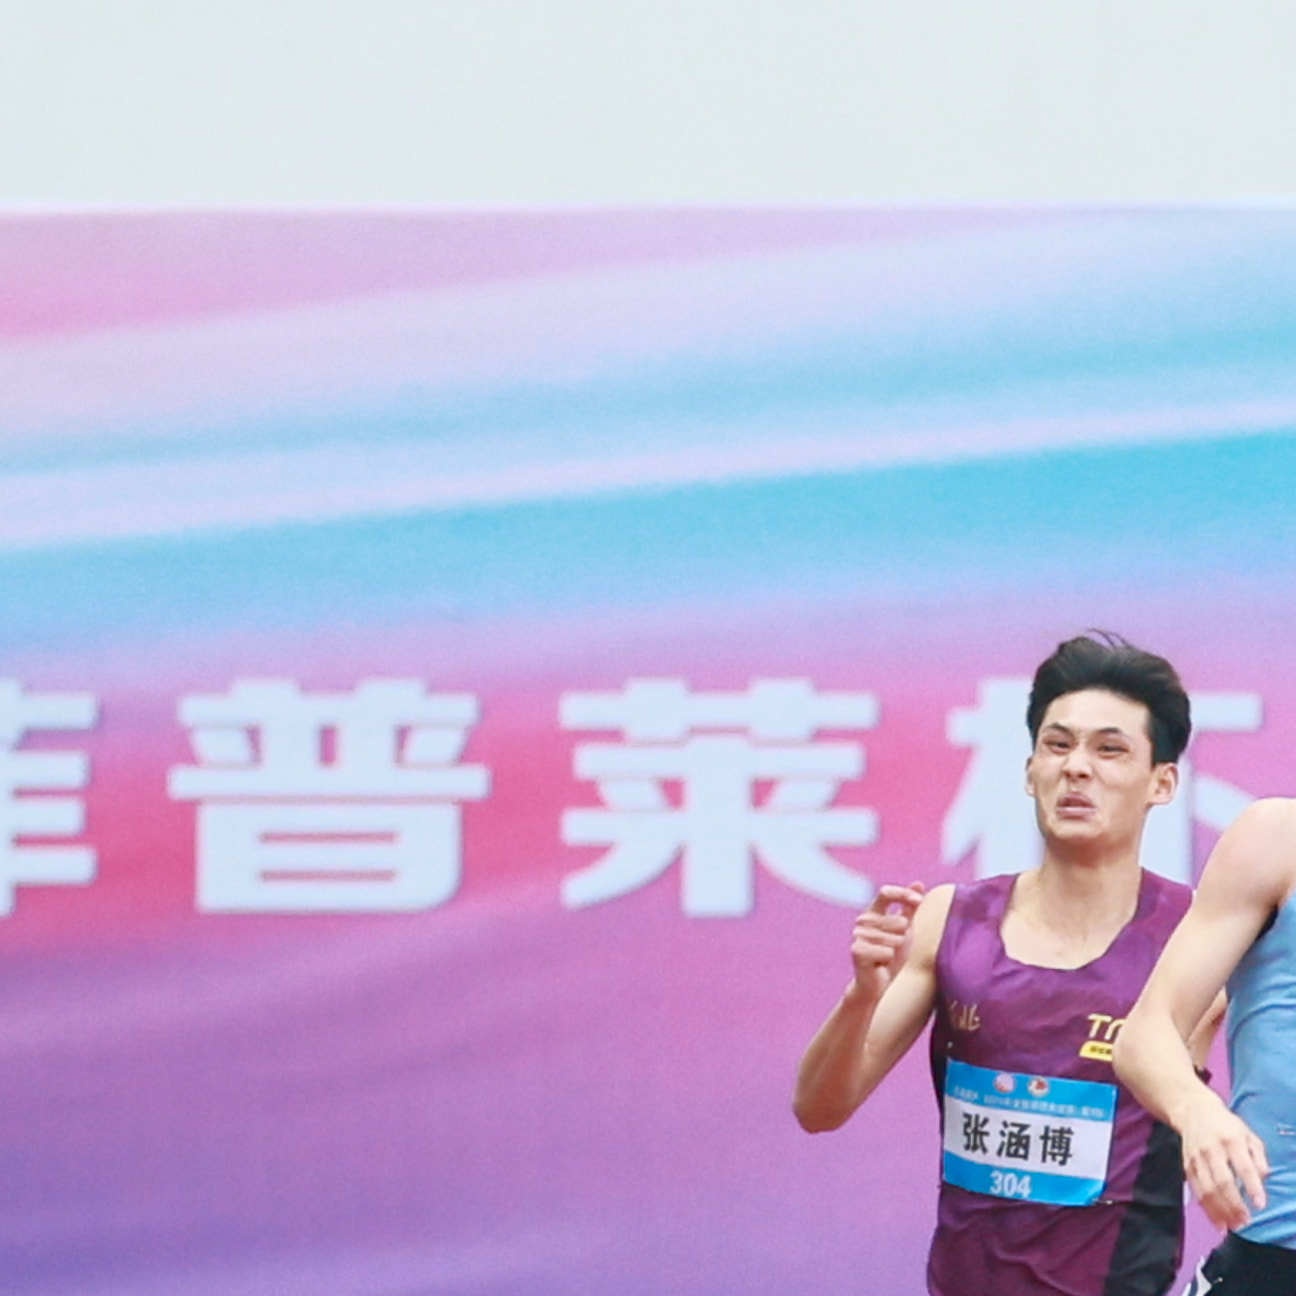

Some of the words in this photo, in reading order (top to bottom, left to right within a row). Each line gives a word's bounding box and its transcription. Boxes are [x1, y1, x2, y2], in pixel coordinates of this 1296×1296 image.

[962, 1112, 1074, 1166] 张涵博
[990, 1170, 1032, 1198] 304
